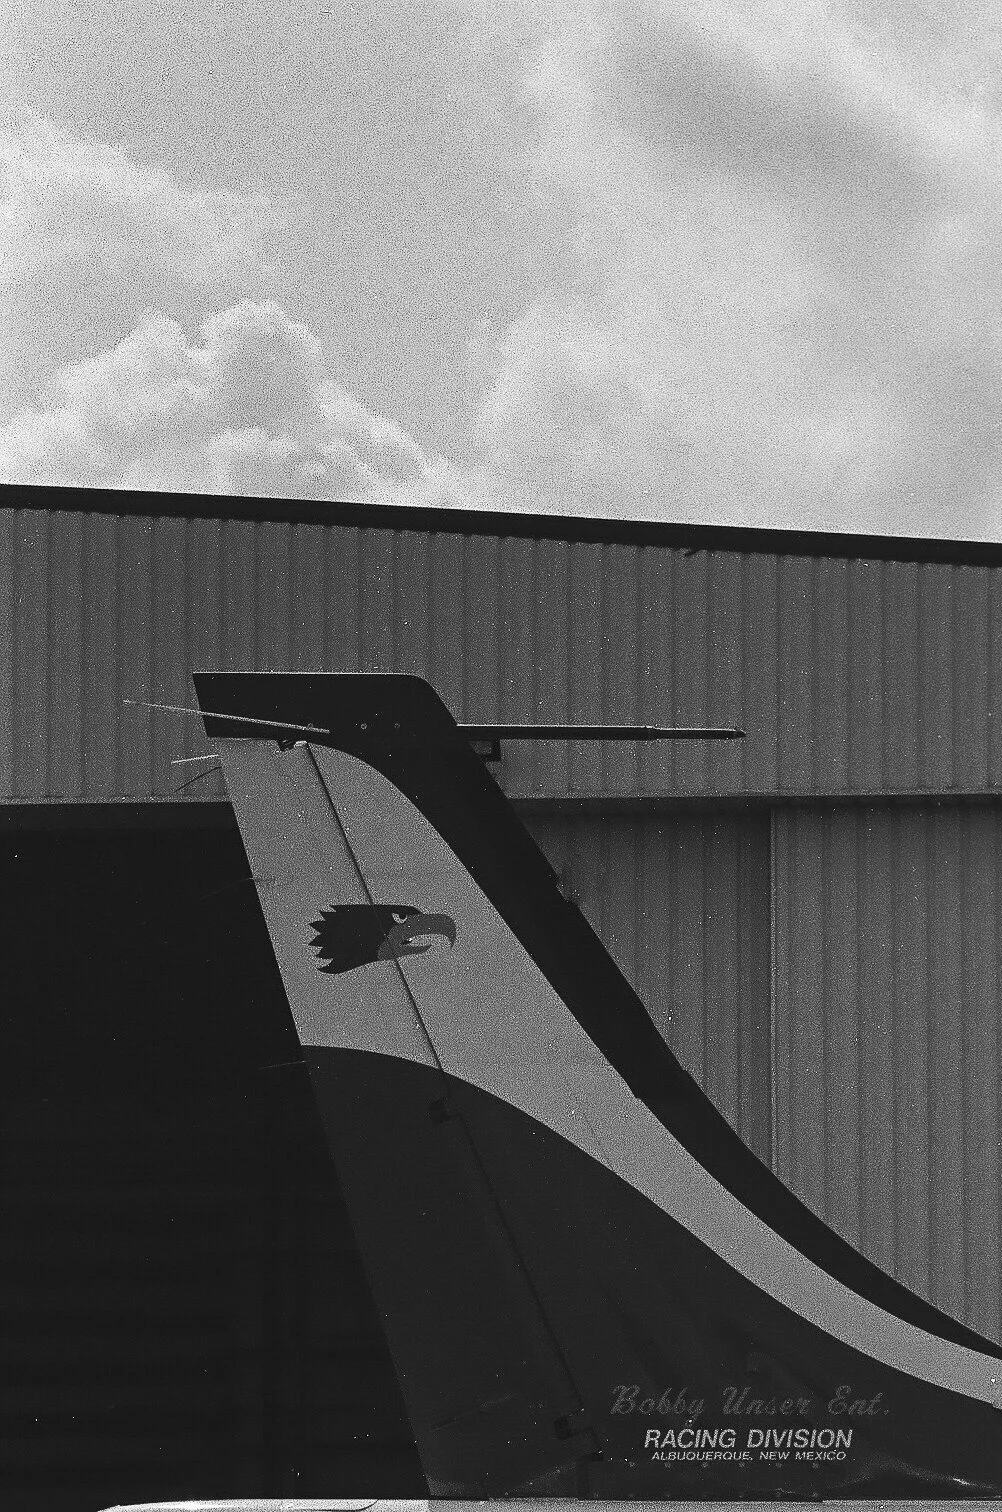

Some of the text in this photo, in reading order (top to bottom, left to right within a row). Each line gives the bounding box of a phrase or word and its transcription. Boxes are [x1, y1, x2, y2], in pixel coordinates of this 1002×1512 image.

[610, 1384, 890, 1427] Bobby Unser Ent.
[644, 1429, 854, 1449] RACING DIVISION
[759, 1450, 790, 1461] NEW
[795, 1450, 847, 1461] MEXICO
